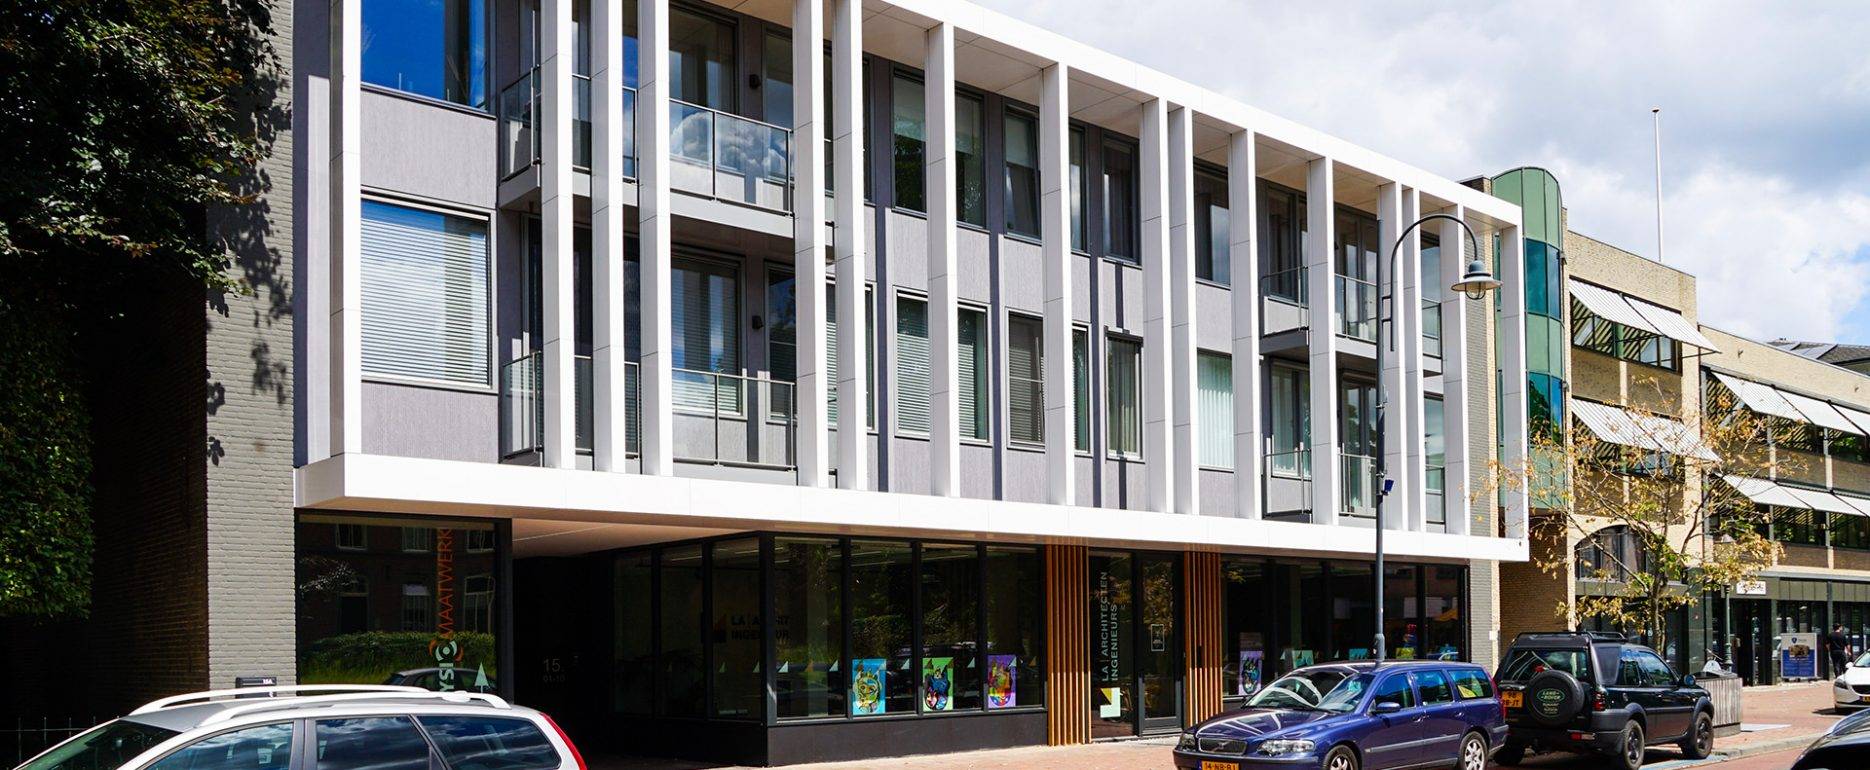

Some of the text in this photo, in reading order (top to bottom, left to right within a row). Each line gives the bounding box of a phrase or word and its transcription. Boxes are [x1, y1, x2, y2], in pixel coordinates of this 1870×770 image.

[437, 529, 454, 639] MAATWERK
[1100, 571, 1109, 657] ARCHITECTEN
[1101, 665, 1109, 682] LA
[1110, 604, 1119, 681] INGENIEURS
